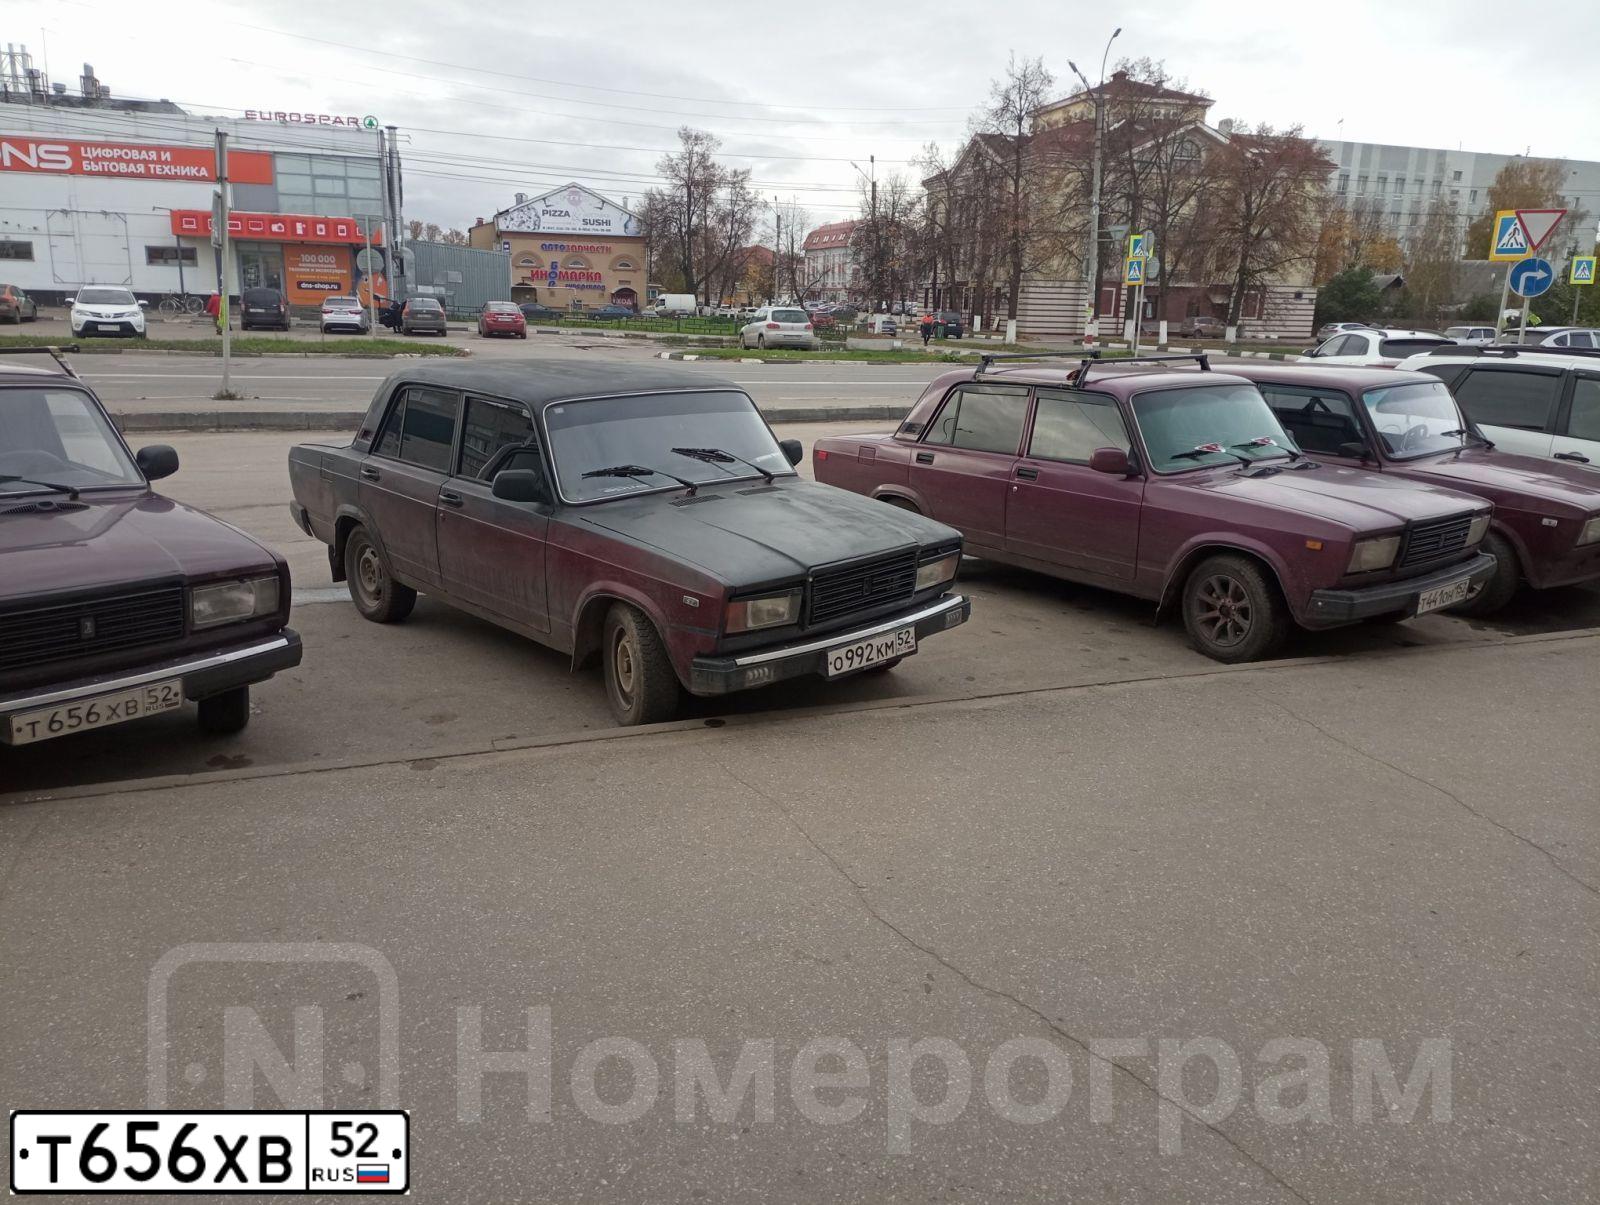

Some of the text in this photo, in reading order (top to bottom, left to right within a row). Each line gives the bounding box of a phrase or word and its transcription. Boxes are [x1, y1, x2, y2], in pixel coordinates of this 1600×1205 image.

[245, 109, 362, 130] EUROSPAR
[0, 141, 73, 170] NS
[80, 146, 171, 161] ЦИФРОВАЯ И
[82, 160, 209, 178] БЫТОВАЯ ТЕХНИКА
[541, 209, 571, 218] PIZZA
[582, 218, 611, 227] SUSHI
[300, 282, 338, 290] dns-shop.ru
[897, 630, 911, 646] 52
[833, 640, 895, 672] О992КМ
[147, 685, 173, 705] 52
[26, 699, 139, 738] Т656ХВ
